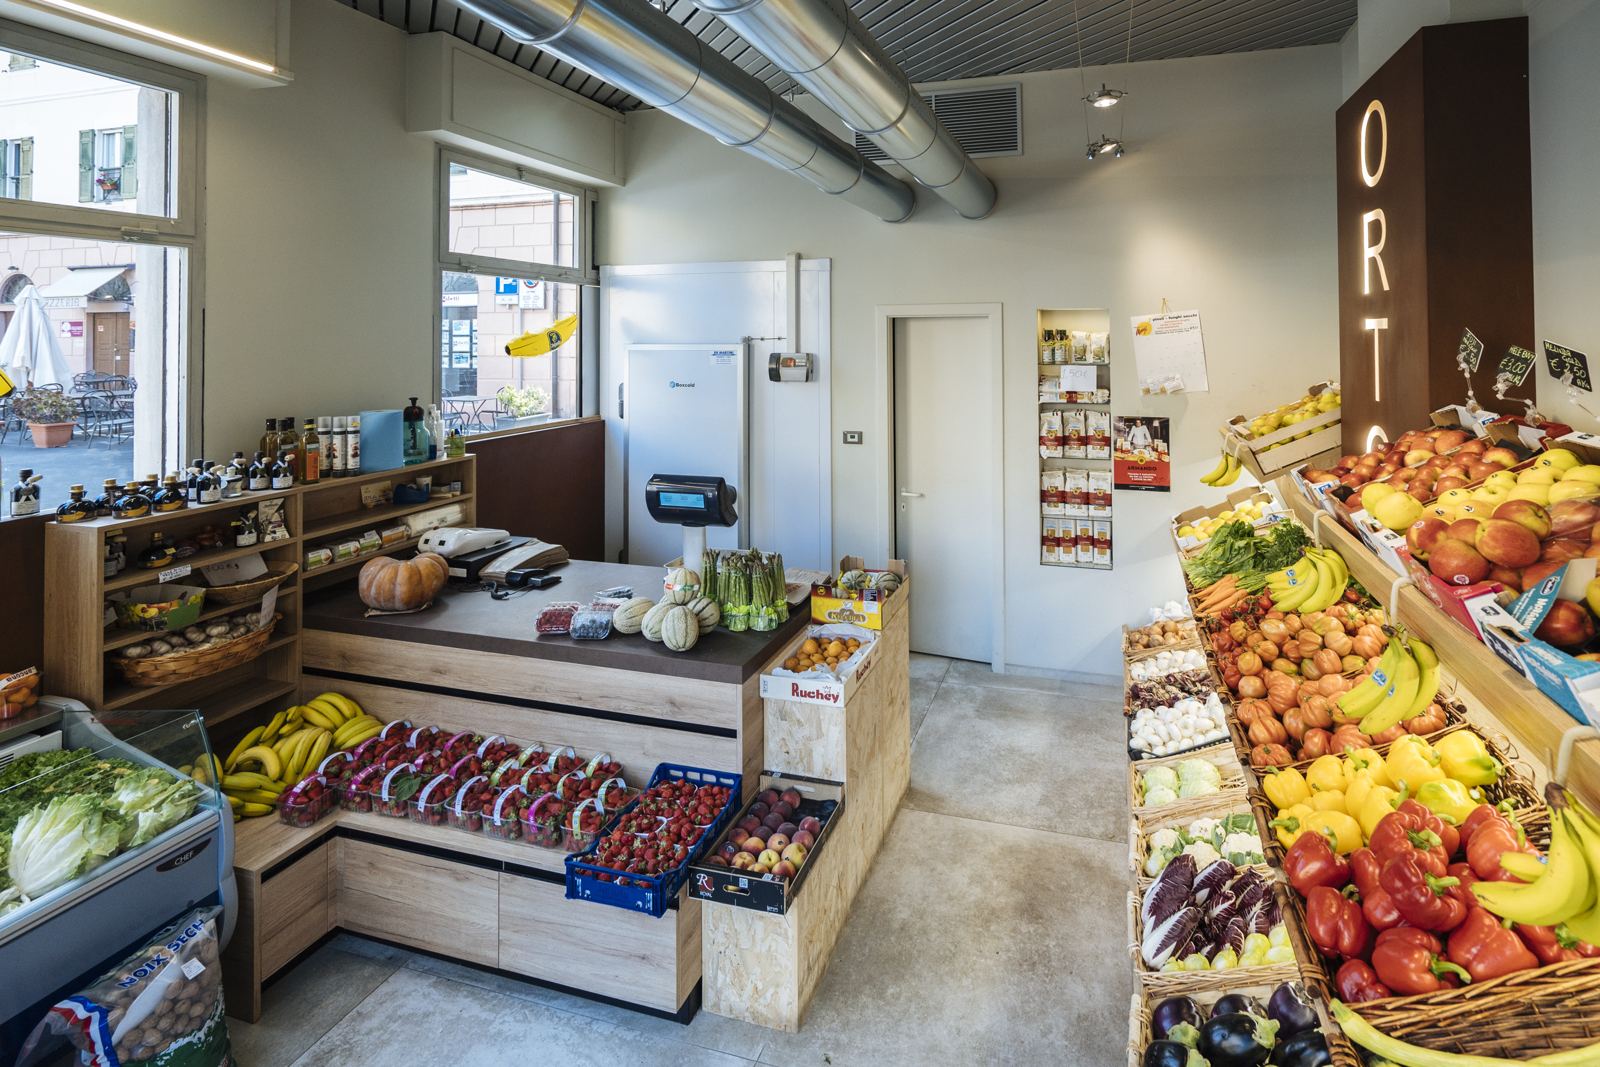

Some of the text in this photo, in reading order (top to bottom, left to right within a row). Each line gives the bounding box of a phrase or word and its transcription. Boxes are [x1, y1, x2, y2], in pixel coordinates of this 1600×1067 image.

[791, 682, 840, 704] Ruchey
[174, 850, 193, 866] CHEF
[116, 952, 169, 989] NOIX
